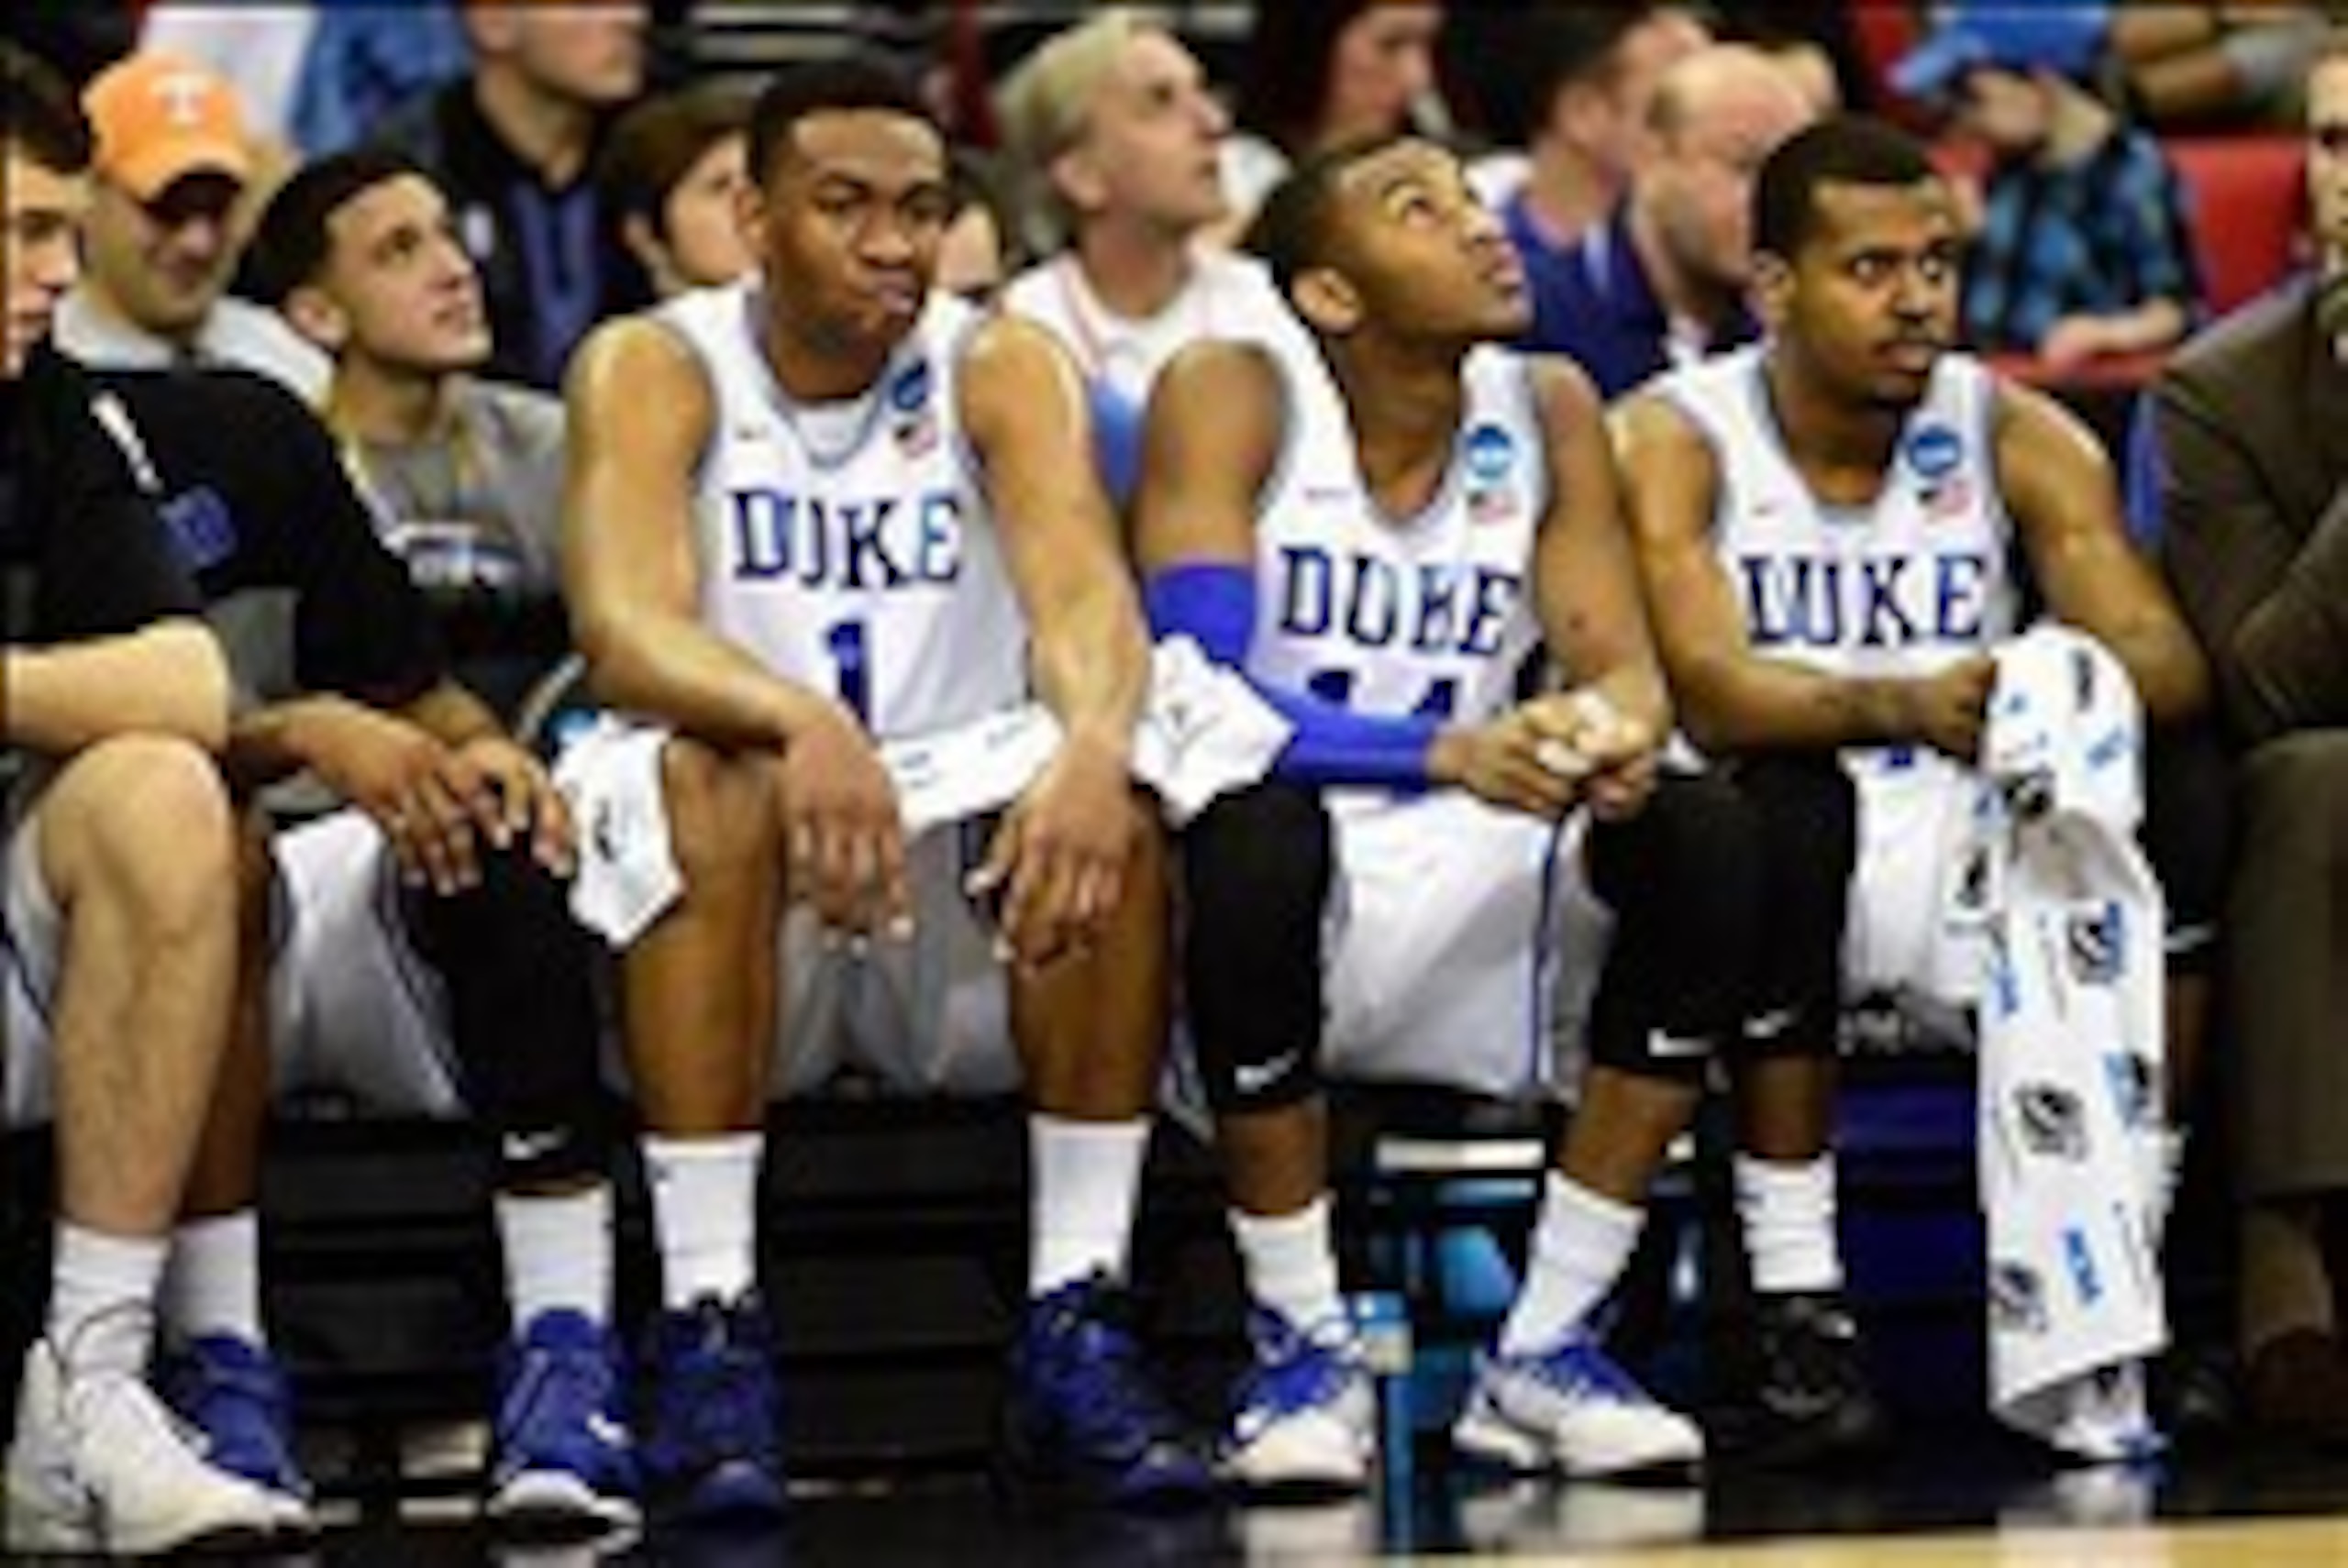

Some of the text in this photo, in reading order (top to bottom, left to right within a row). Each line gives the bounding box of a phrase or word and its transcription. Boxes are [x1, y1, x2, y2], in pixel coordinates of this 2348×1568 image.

[730, 489, 961, 589] DUKE
[1280, 545, 1521, 656] DUKE
[1741, 555, 1985, 645] DUKE
